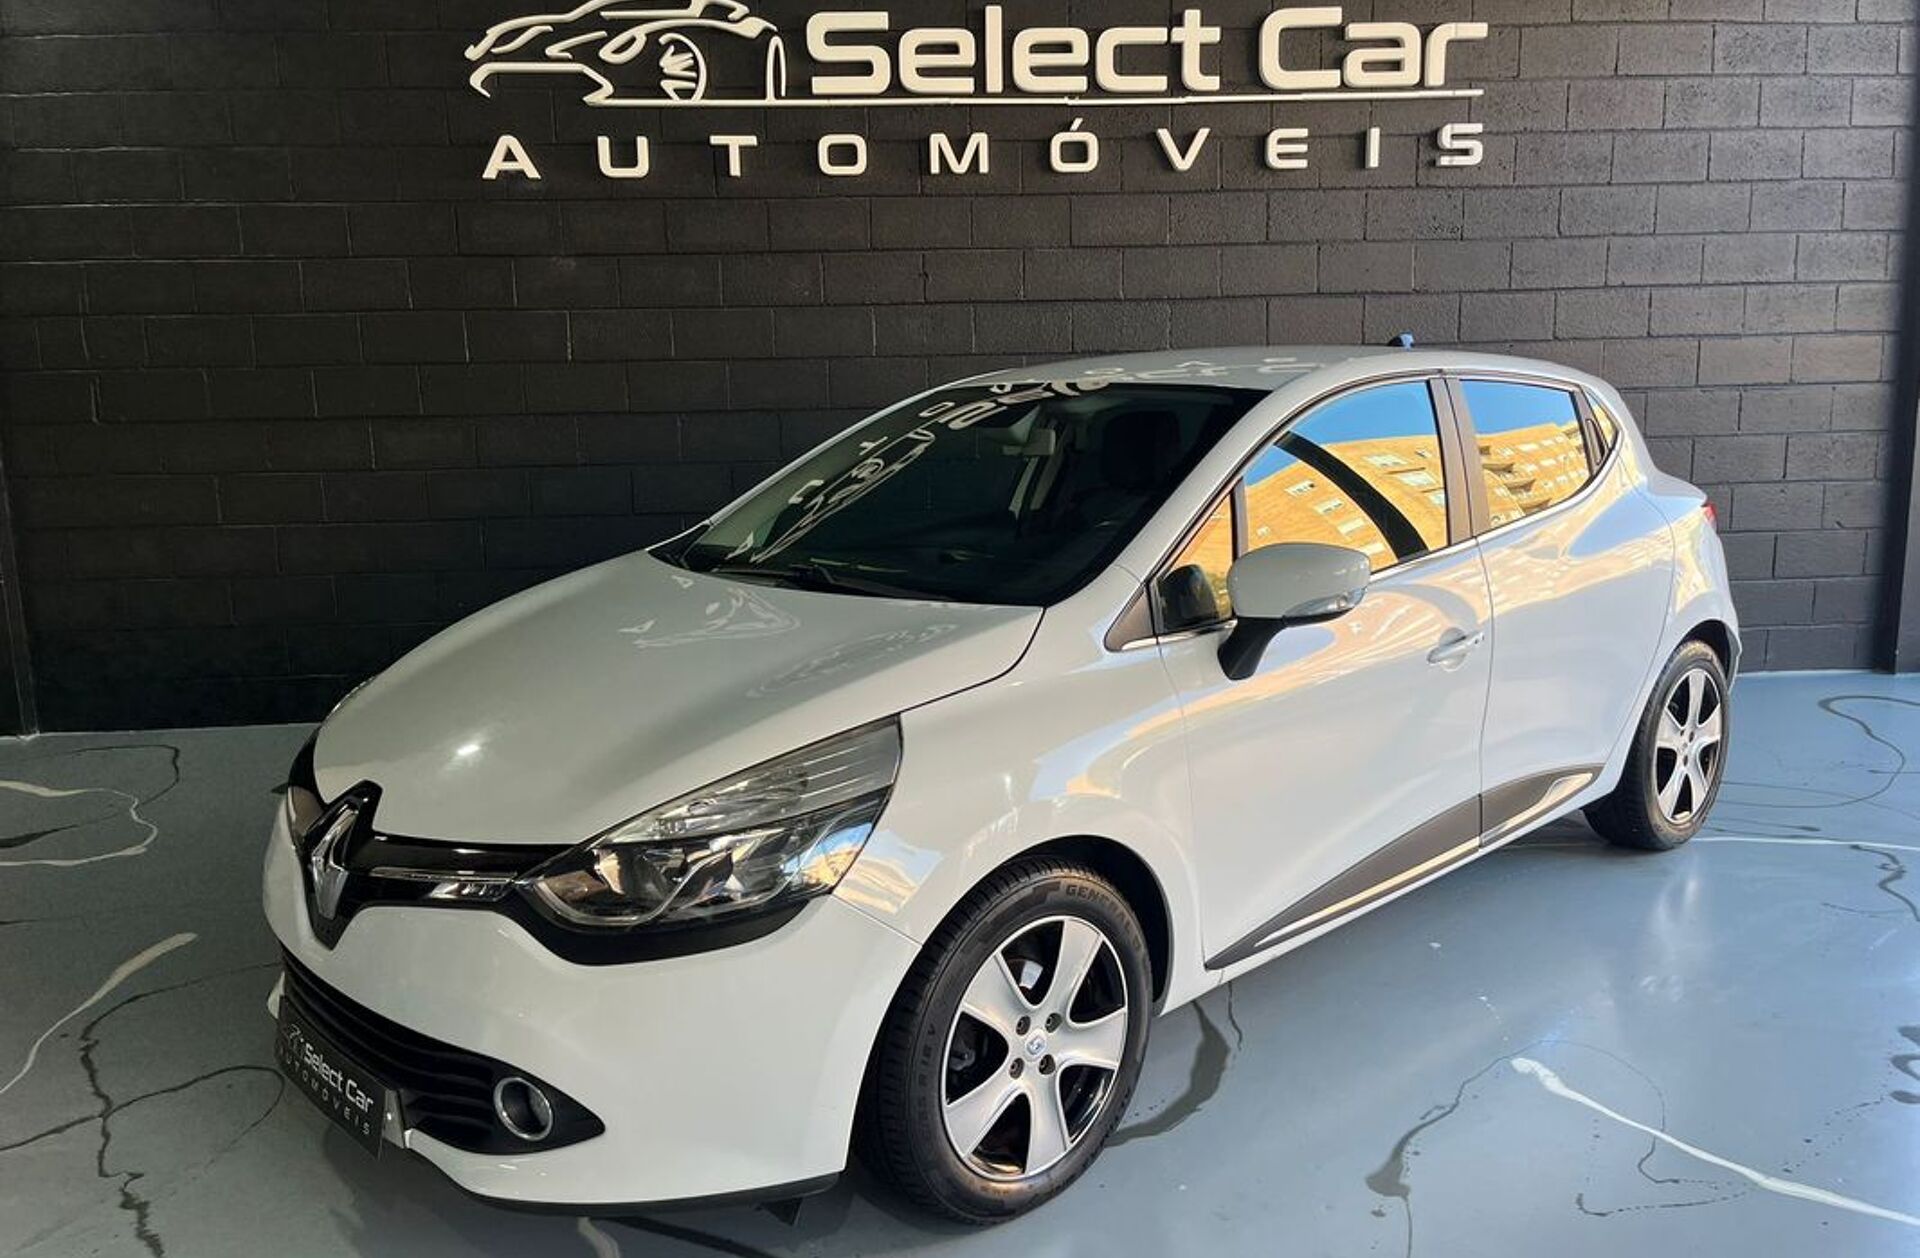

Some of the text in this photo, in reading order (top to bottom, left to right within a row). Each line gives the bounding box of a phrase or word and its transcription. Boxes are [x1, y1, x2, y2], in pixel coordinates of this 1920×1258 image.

[806, 5, 1489, 95] Select Car
[482, 117, 1485, 180] AUTOMÓVEIS
[303, 1042, 374, 1112] Select Car
